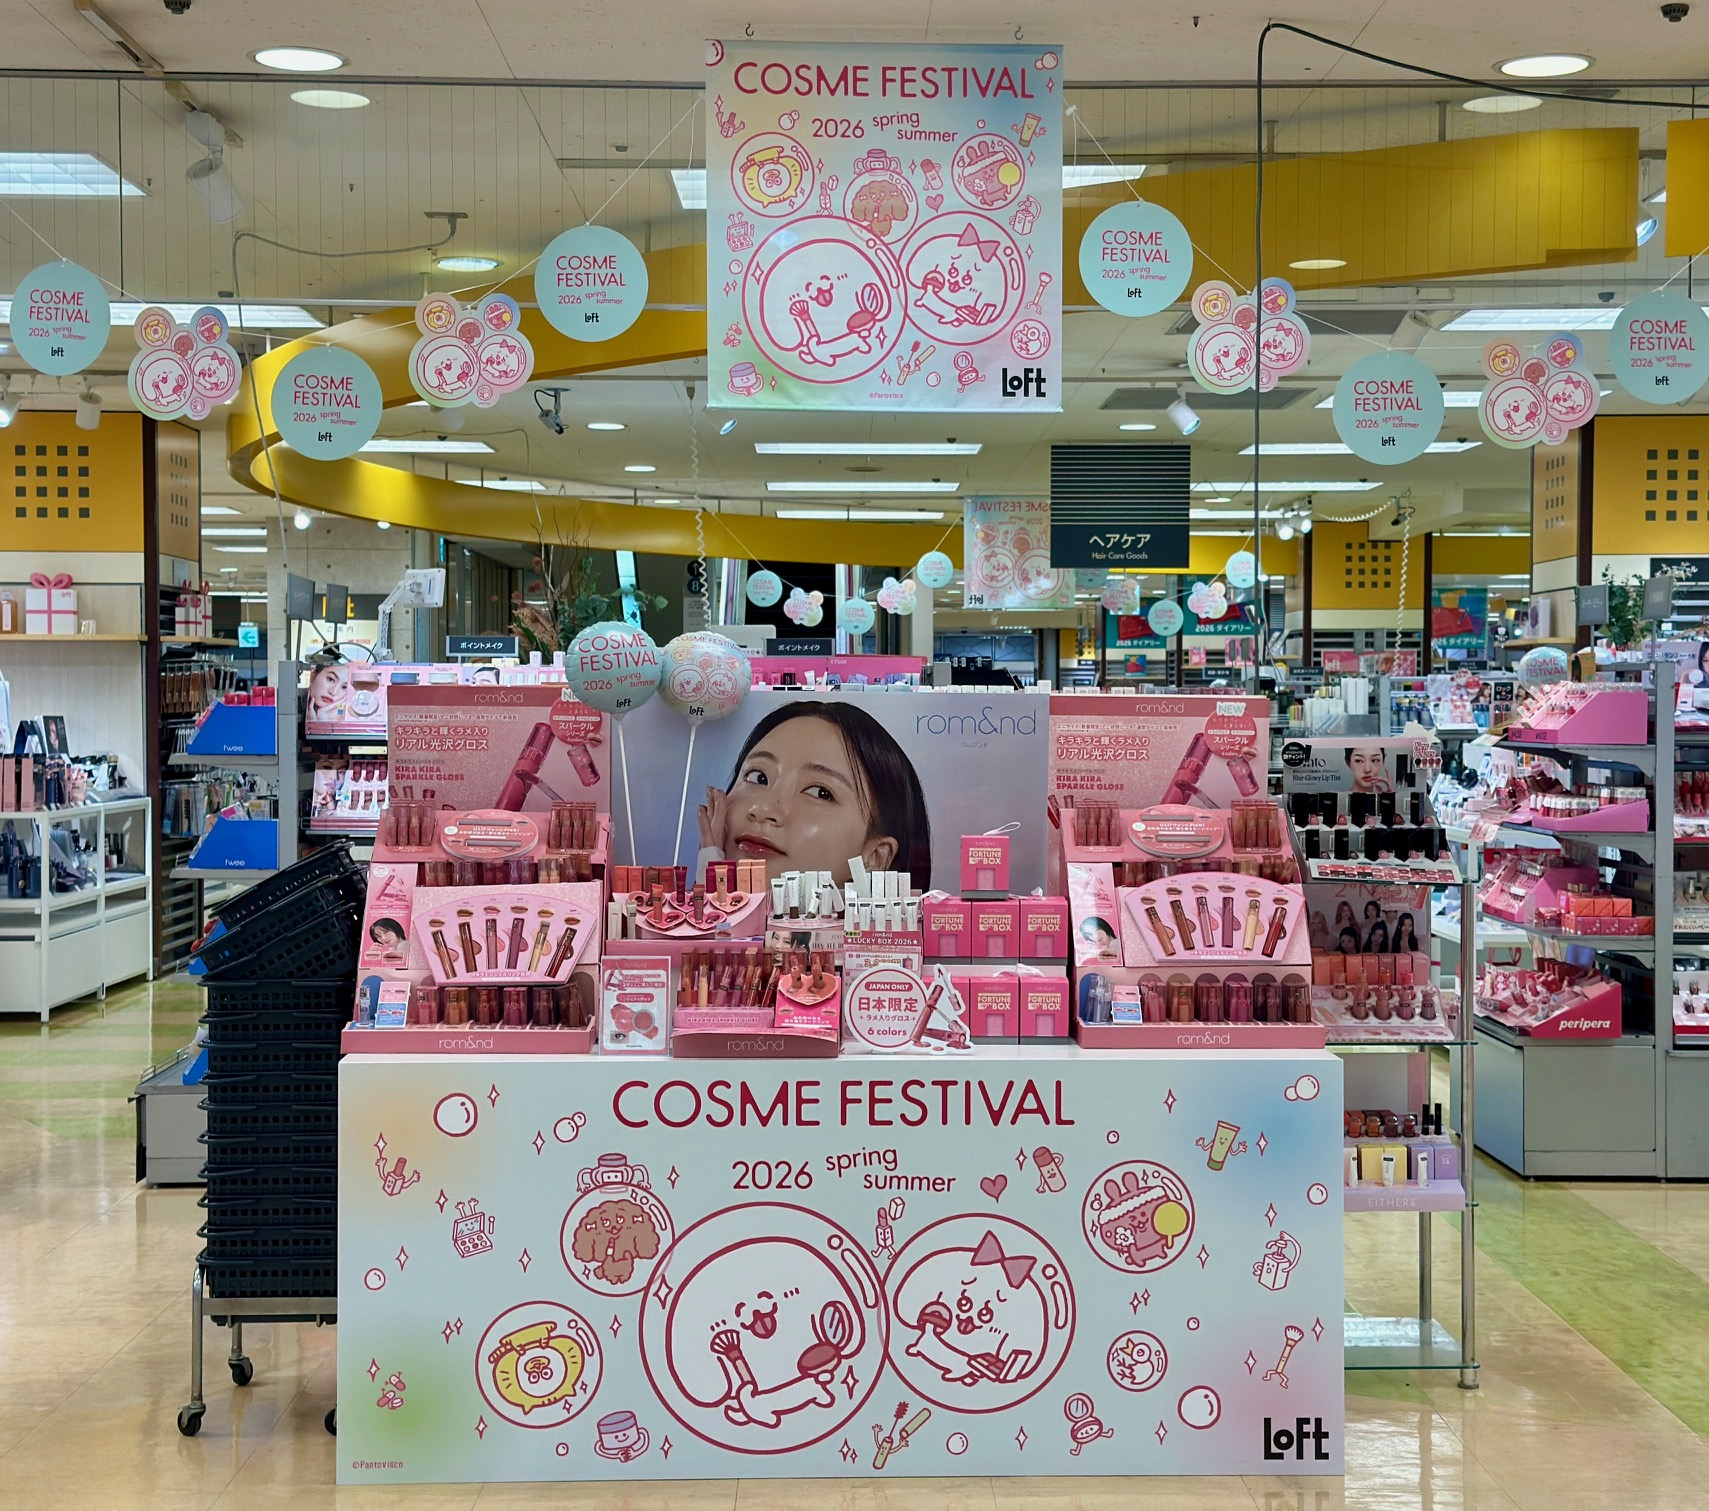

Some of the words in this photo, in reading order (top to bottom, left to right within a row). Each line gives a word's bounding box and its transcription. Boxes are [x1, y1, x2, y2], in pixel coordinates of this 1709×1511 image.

[733, 61, 870, 98] COSME
[881, 66, 1035, 99] FESTIVAL
[811, 118, 865, 139] 2026
[872, 111, 920, 129] spring
[897, 128, 958, 143] summer
[1102, 230, 1163, 246] COSME
[1102, 247, 1171, 263] FESTIVAL
[556, 255, 617, 270] COSME
[1102, 269, 1126, 279] 2026
[1129, 267, 1151, 275] spring
[557, 273, 626, 287] FESTIVAL
[30, 289, 84, 306] COSME
[558, 295, 582, 305] 2026
[585, 291, 607, 300] spring
[29, 307, 91, 323] FESTIVAL
[29, 327, 50, 338] 2026
[53, 326, 72, 335] spring
[1629, 320, 1687, 334] COSME
[62, 333, 87, 341] summer
[1630, 337, 1695, 351] FESTIVAL
[1630, 358, 1653, 368] 2026
[1656, 355, 1677, 363] spring
[293, 374, 353, 391] COSME
[1354, 380, 1414, 395] COSME
[293, 391, 361, 408] FESTIVAL
[1354, 397, 1423, 412] FESTIVAL
[293, 412, 317, 423] 2026
[320, 411, 341, 419] spring
[330, 418, 357, 426] summer
[1355, 419, 1379, 429] 2026
[1382, 415, 1403, 424] spring
[1392, 421, 1420, 429] summer
[1089, 533, 1151, 549] ヘアケア
[1092, 551, 1107, 560] Hair
[1108, 551, 1125, 560] Care
[1126, 551, 1148, 560] Goods
[692, 581, 699, 591] 8
[1195, 624, 1215, 632] 2026
[1216, 624, 1252, 632] ダイアリー
[578, 633, 648, 653] COSME
[1132, 639, 1160, 647] ダイアリー
[1449, 638, 1484, 646] ダイアリー
[580, 650, 659, 673] FESTIVAL
[583, 679, 613, 691] 2026
[616, 672, 642, 684] spring
[630, 679, 656, 688] summer
[474, 691, 524, 703] rom&nd
[1136, 701, 1185, 713] rom&nd
[1218, 704, 1245, 715] NEW
[558, 722, 594, 730] スパークル
[916, 706, 1036, 735] rom&nd
[396, 726, 489, 736] キラキラと輝くラメ入り
[396, 738, 488, 751] リアル光沢グロス
[1058, 736, 1150, 746] キラキラと輝くラメ入り
[1213, 736, 1249, 744] スパークル
[223, 744, 243, 752] fwee
[1058, 748, 1148, 760] リアル光沢グロス
[395, 773, 434, 781] SPARKLE
[436, 773, 465, 781] GLOSS
[969, 848, 1001, 857] FORTUNE
[225, 858, 245, 867] fwee
[983, 857, 1001, 865] BOX
[931, 914, 964, 924] FORTUNE
[979, 914, 1012, 924] FORTUNE
[1027, 914, 1060, 924] FORTUNE
[993, 924, 1012, 932] BOX
[1042, 924, 1060, 932] BOX
[977, 993, 1011, 1003] FORTUNE
[1028, 993, 1061, 1003] FORTUNE
[858, 997, 918, 1013] 日本限定
[1042, 1003, 1061, 1011] BOX
[1559, 1018, 1610, 1030] peripera
[868, 1027, 874, 1035] 6
[877, 1027, 907, 1036] colors
[438, 1036, 494, 1049] rom&nd
[727, 1037, 784, 1051] rom&nd
[1177, 1031, 1230, 1045] rom&nd
[612, 1080, 821, 1128] COSME
[840, 1079, 1075, 1127] FESTIVAL
[732, 1161, 813, 1190] 2026
[826, 1147, 898, 1177] spring
[863, 1171, 956, 1192] summer
